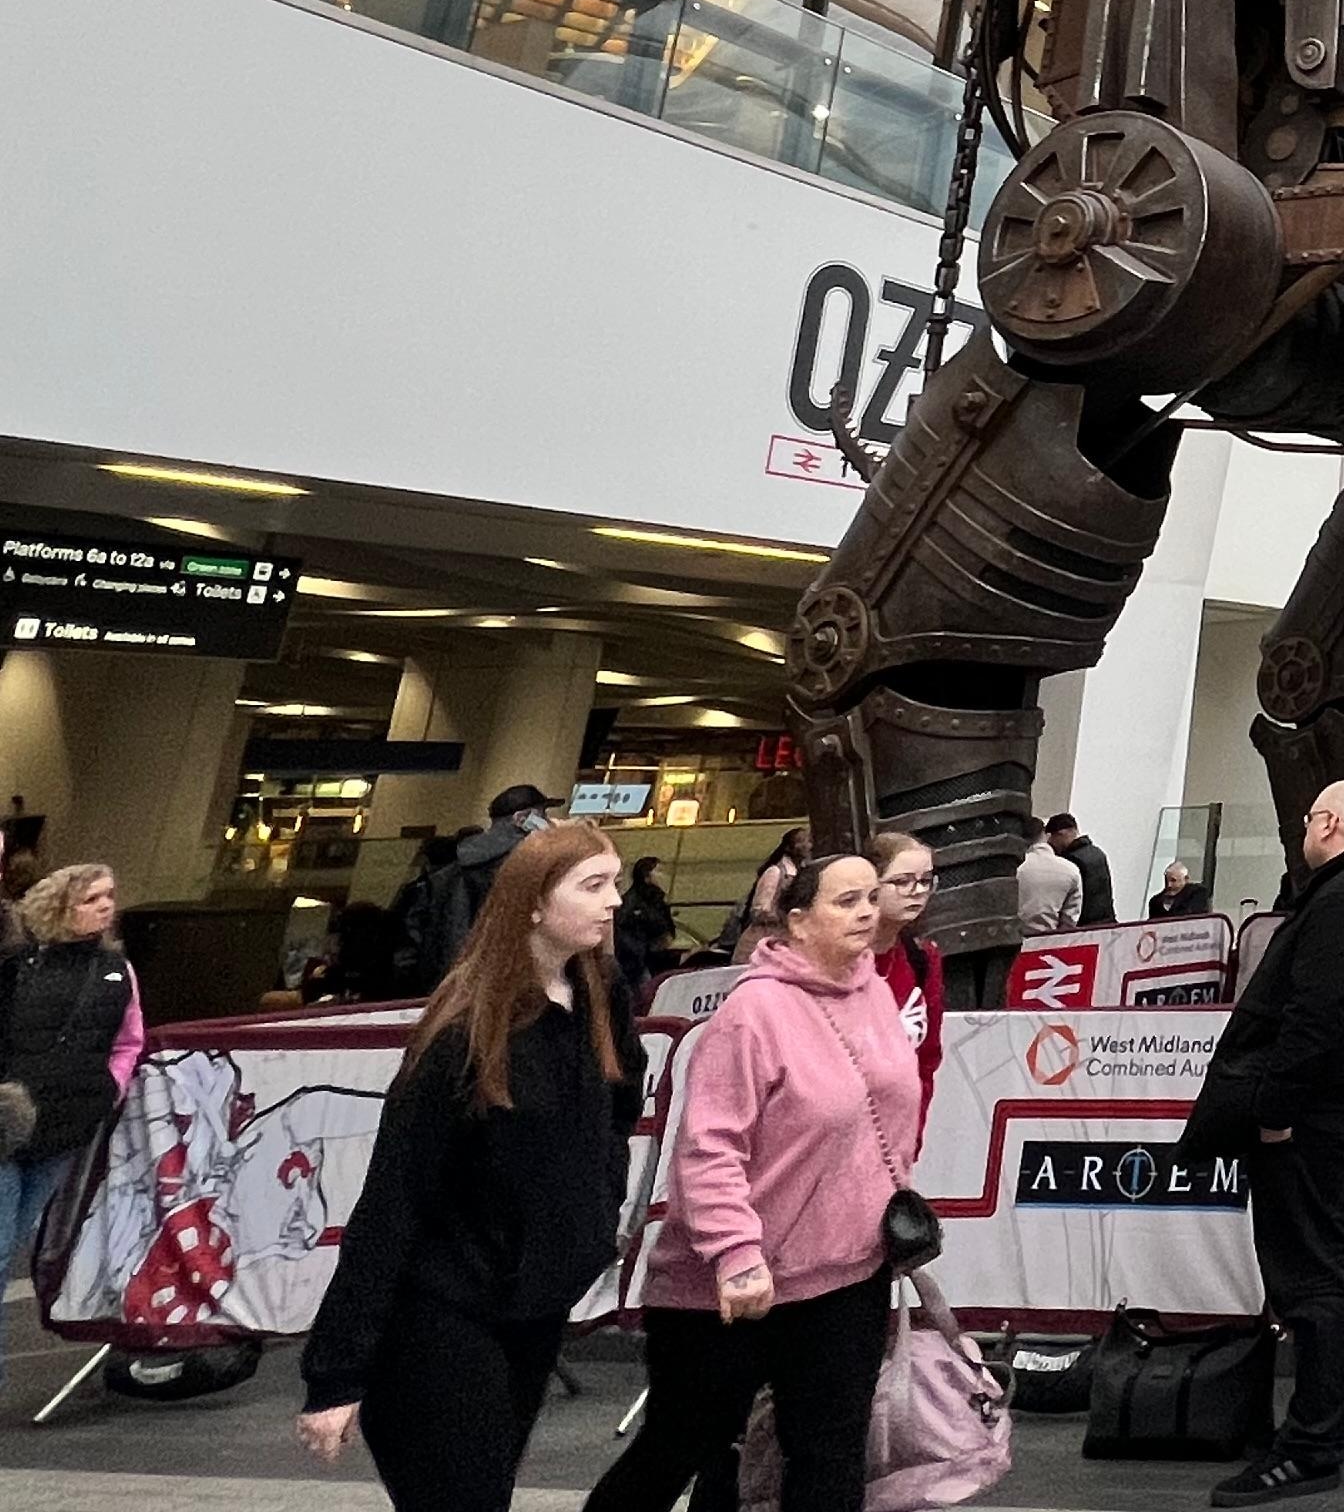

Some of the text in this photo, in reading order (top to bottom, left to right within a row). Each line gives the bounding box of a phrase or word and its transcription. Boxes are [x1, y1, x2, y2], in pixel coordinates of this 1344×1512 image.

[2, 540, 84, 562] Platforms
[86, 548, 108, 564] 6a
[109, 550, 128, 566] to
[130, 552, 155, 568] 12a
[195, 581, 243, 600] Toilets
[43, 620, 99, 640] Toilets
[755, 735, 802, 771] LE
[692, 991, 729, 1015] OZZ
[1089, 1036, 1218, 1055] West Midland
[1085, 1059, 1176, 1078] Combined
